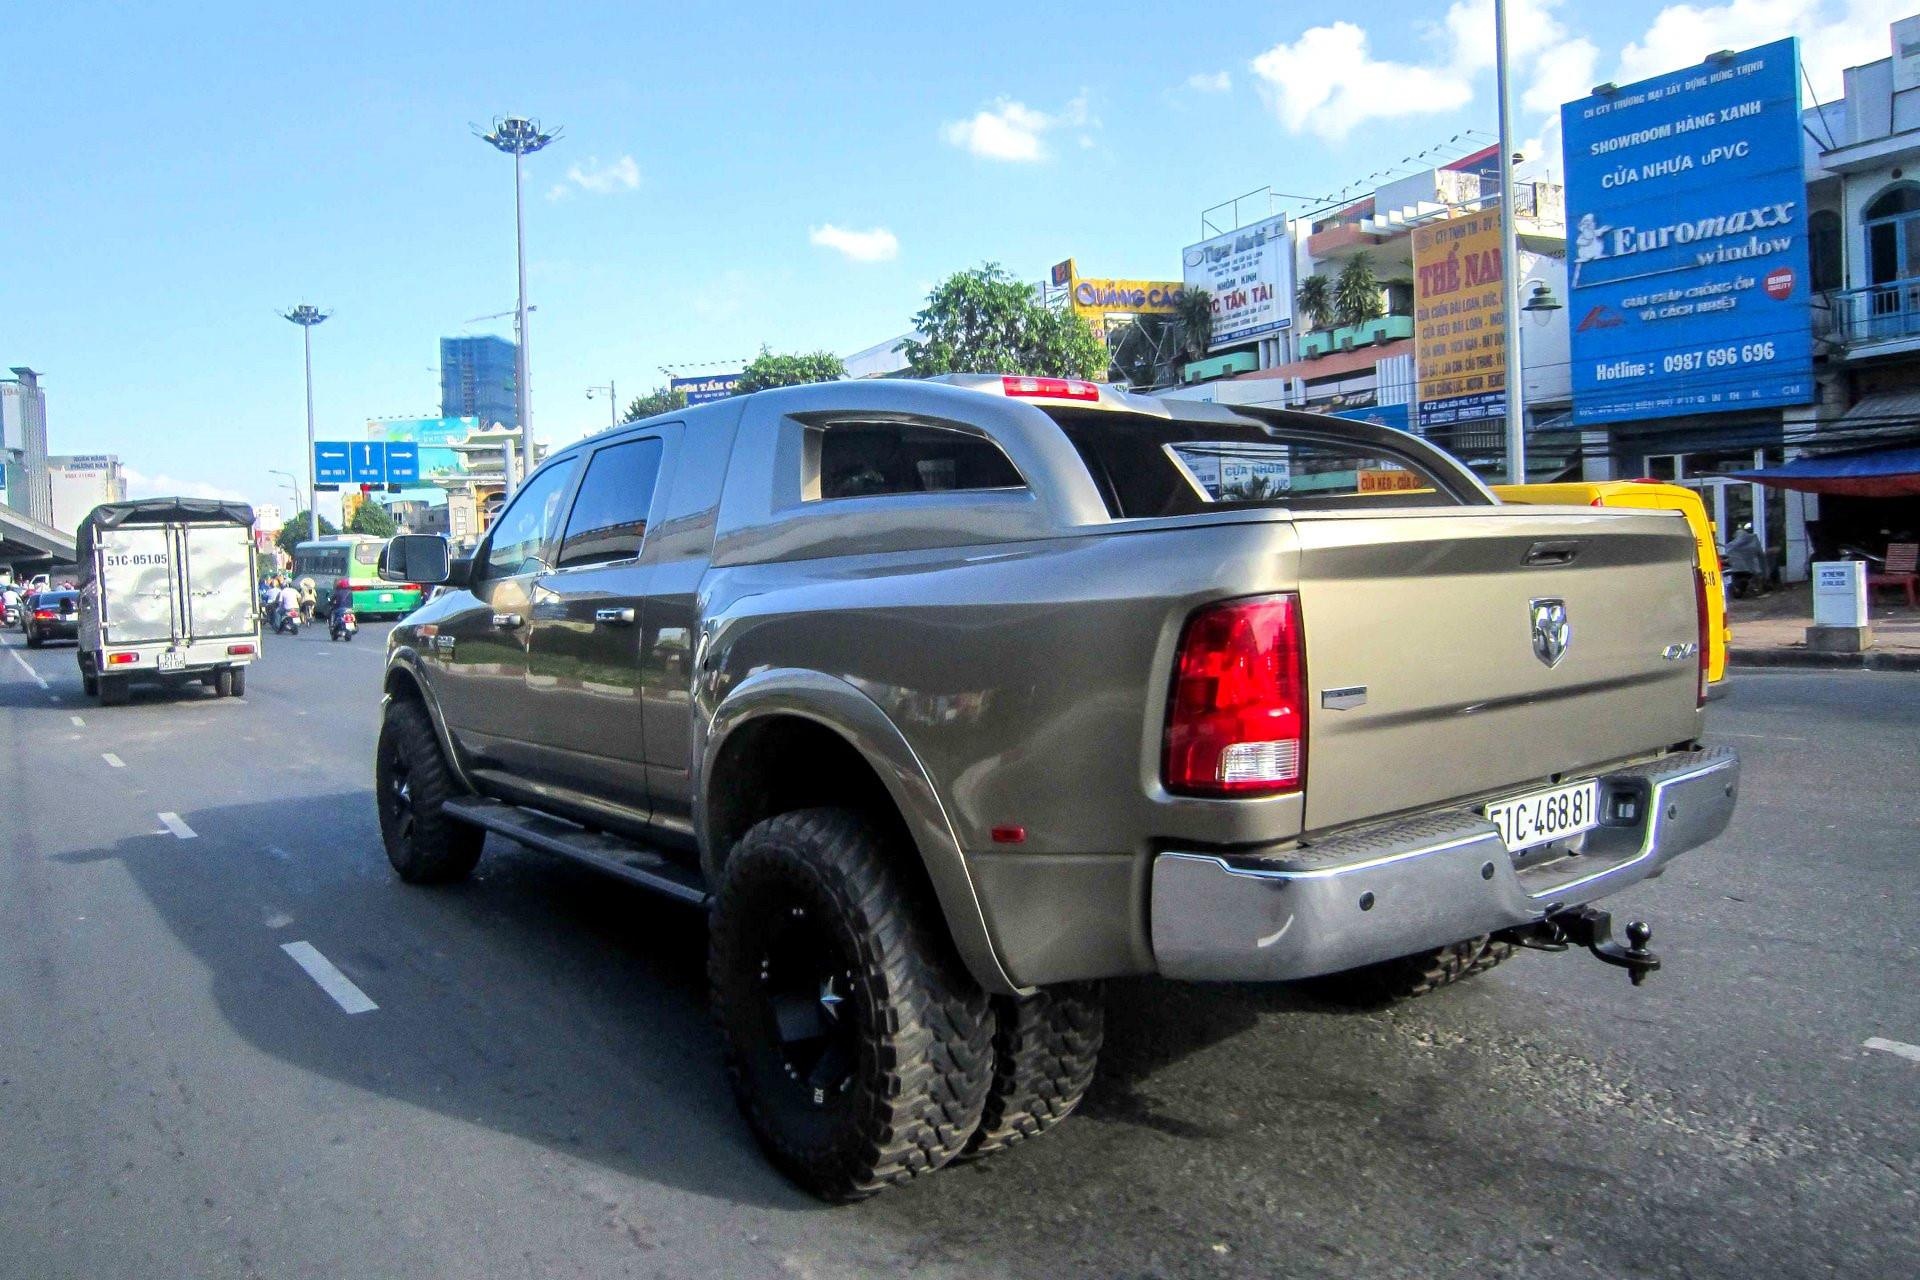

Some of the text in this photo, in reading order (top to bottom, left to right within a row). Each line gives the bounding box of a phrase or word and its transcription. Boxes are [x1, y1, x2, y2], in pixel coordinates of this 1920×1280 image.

[1591, 101, 1761, 156] SHOWROOM HÀNG XANH
[1602, 164, 1638, 189] CỬA
[1643, 154, 1693, 177] NHỰA
[1613, 202, 1796, 254] Euromaxx
[1696, 235, 1792, 266] window
[1224, 288, 1247, 310] TẤN
[1251, 281, 1273, 303] TÀI
[1597, 361, 1645, 381] Hotline
[1663, 352, 1703, 373] 0987
[1706, 347, 1737, 367] 696
[1742, 341, 1775, 363] 696
